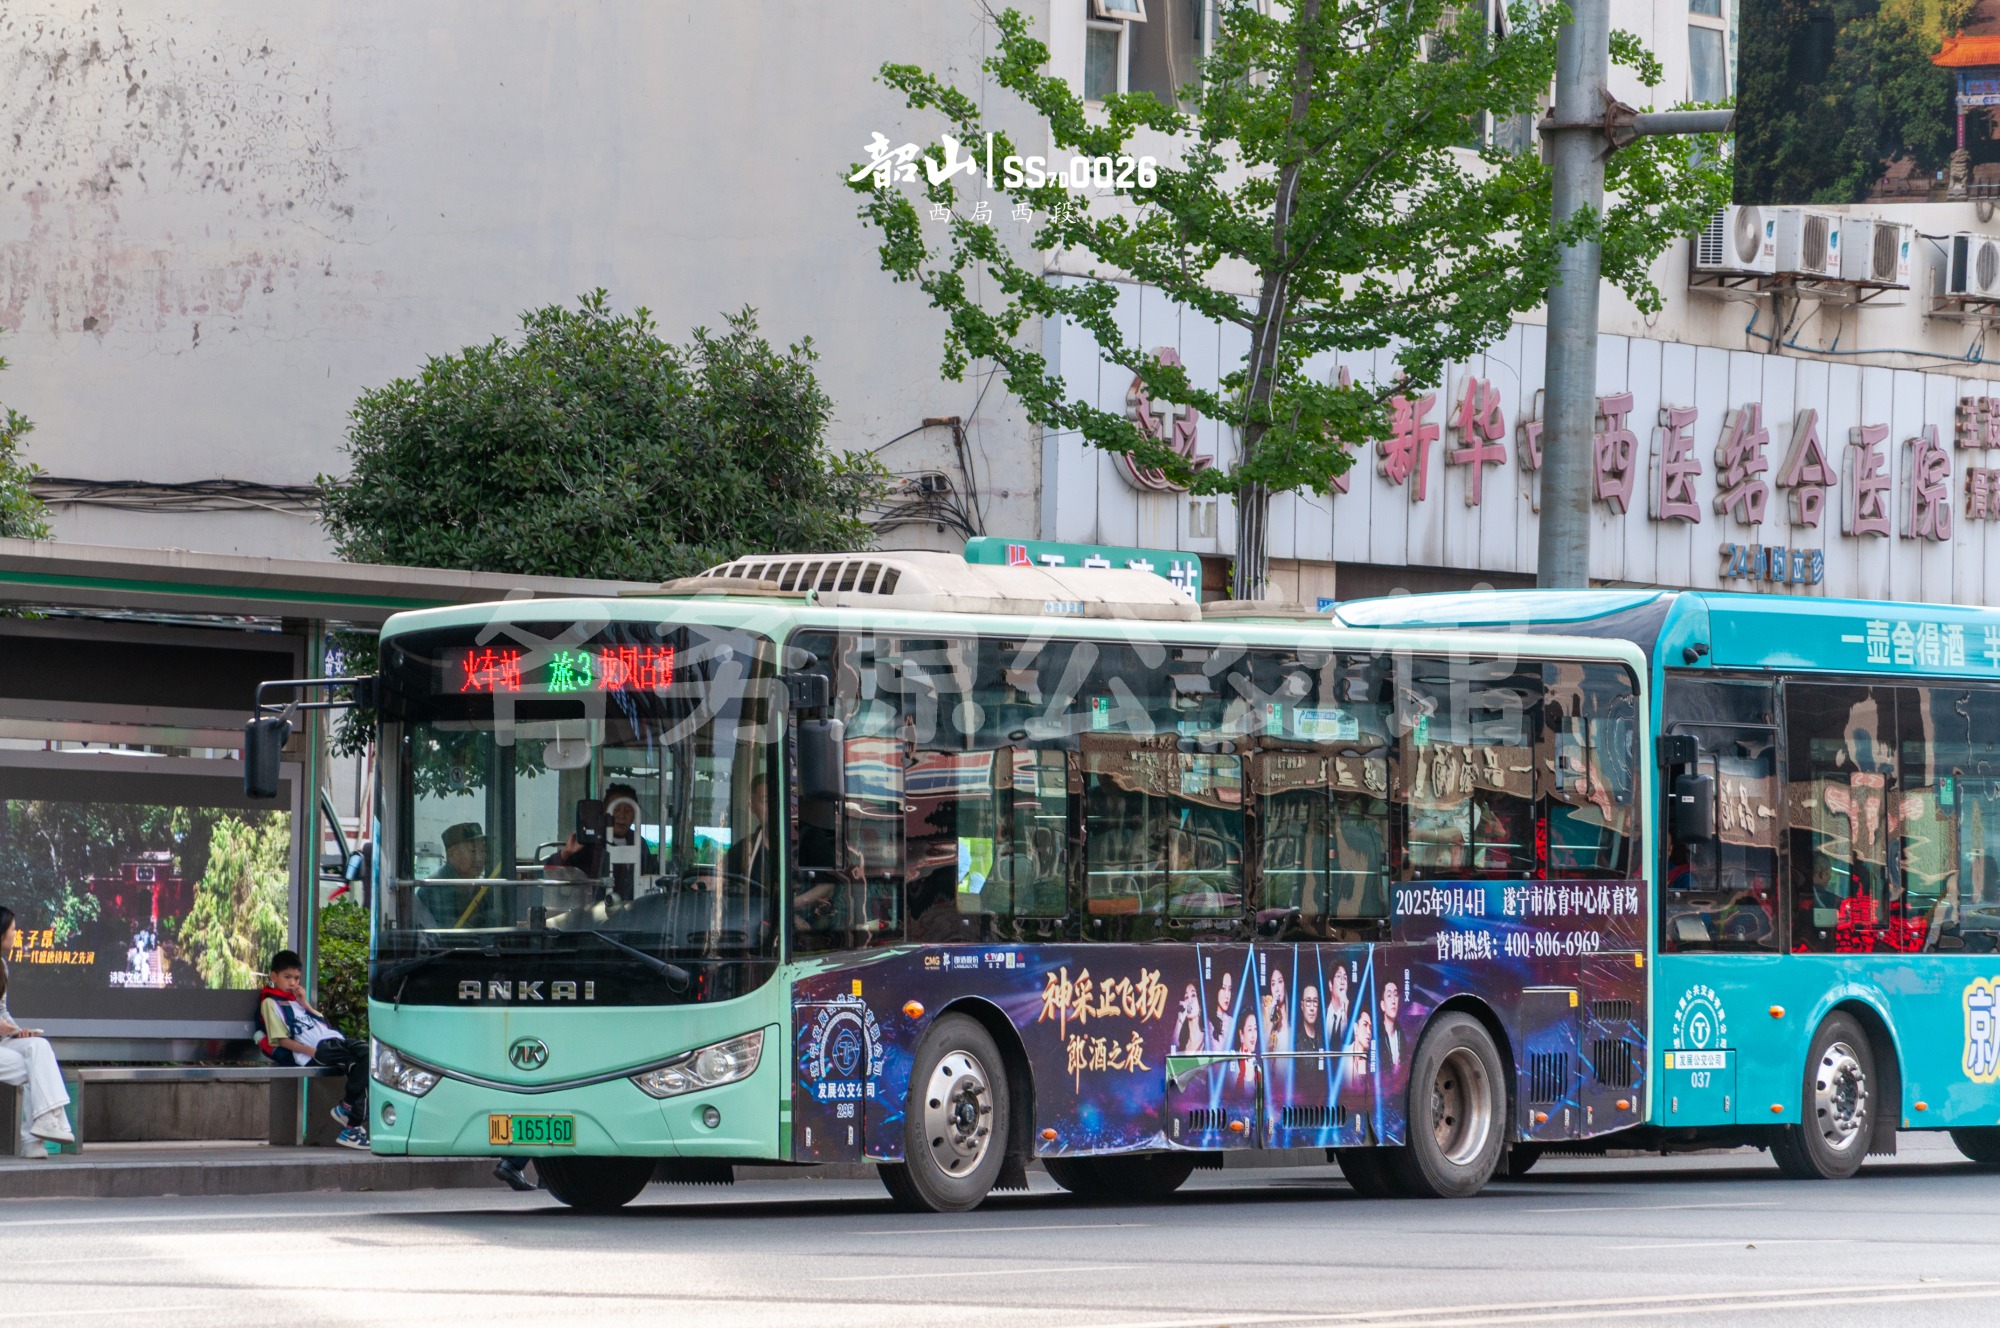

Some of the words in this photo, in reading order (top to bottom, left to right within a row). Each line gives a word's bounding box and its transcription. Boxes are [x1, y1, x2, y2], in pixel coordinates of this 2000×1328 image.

[1722, 543, 1825, 585] 24小时应诊
[1841, 620, 1965, 667] 一壶舍得酒
[460, 649, 521, 692] 火车站
[1396, 887, 1485, 917] 2025年9月4日
[1503, 885, 1638, 917] 遂宁市体育中心体育场
[925, 956, 940, 966] CMG
[458, 980, 594, 1000] ANKAI
[1038, 966, 1168, 1041] 神采正飞扬
[1067, 1030, 1152, 1095] 郎酒之夜
[818, 1082, 875, 1098] 发展公交公司
[1690, 1071, 1711, 1088] 037
[836, 1103, 855, 1118] 295
